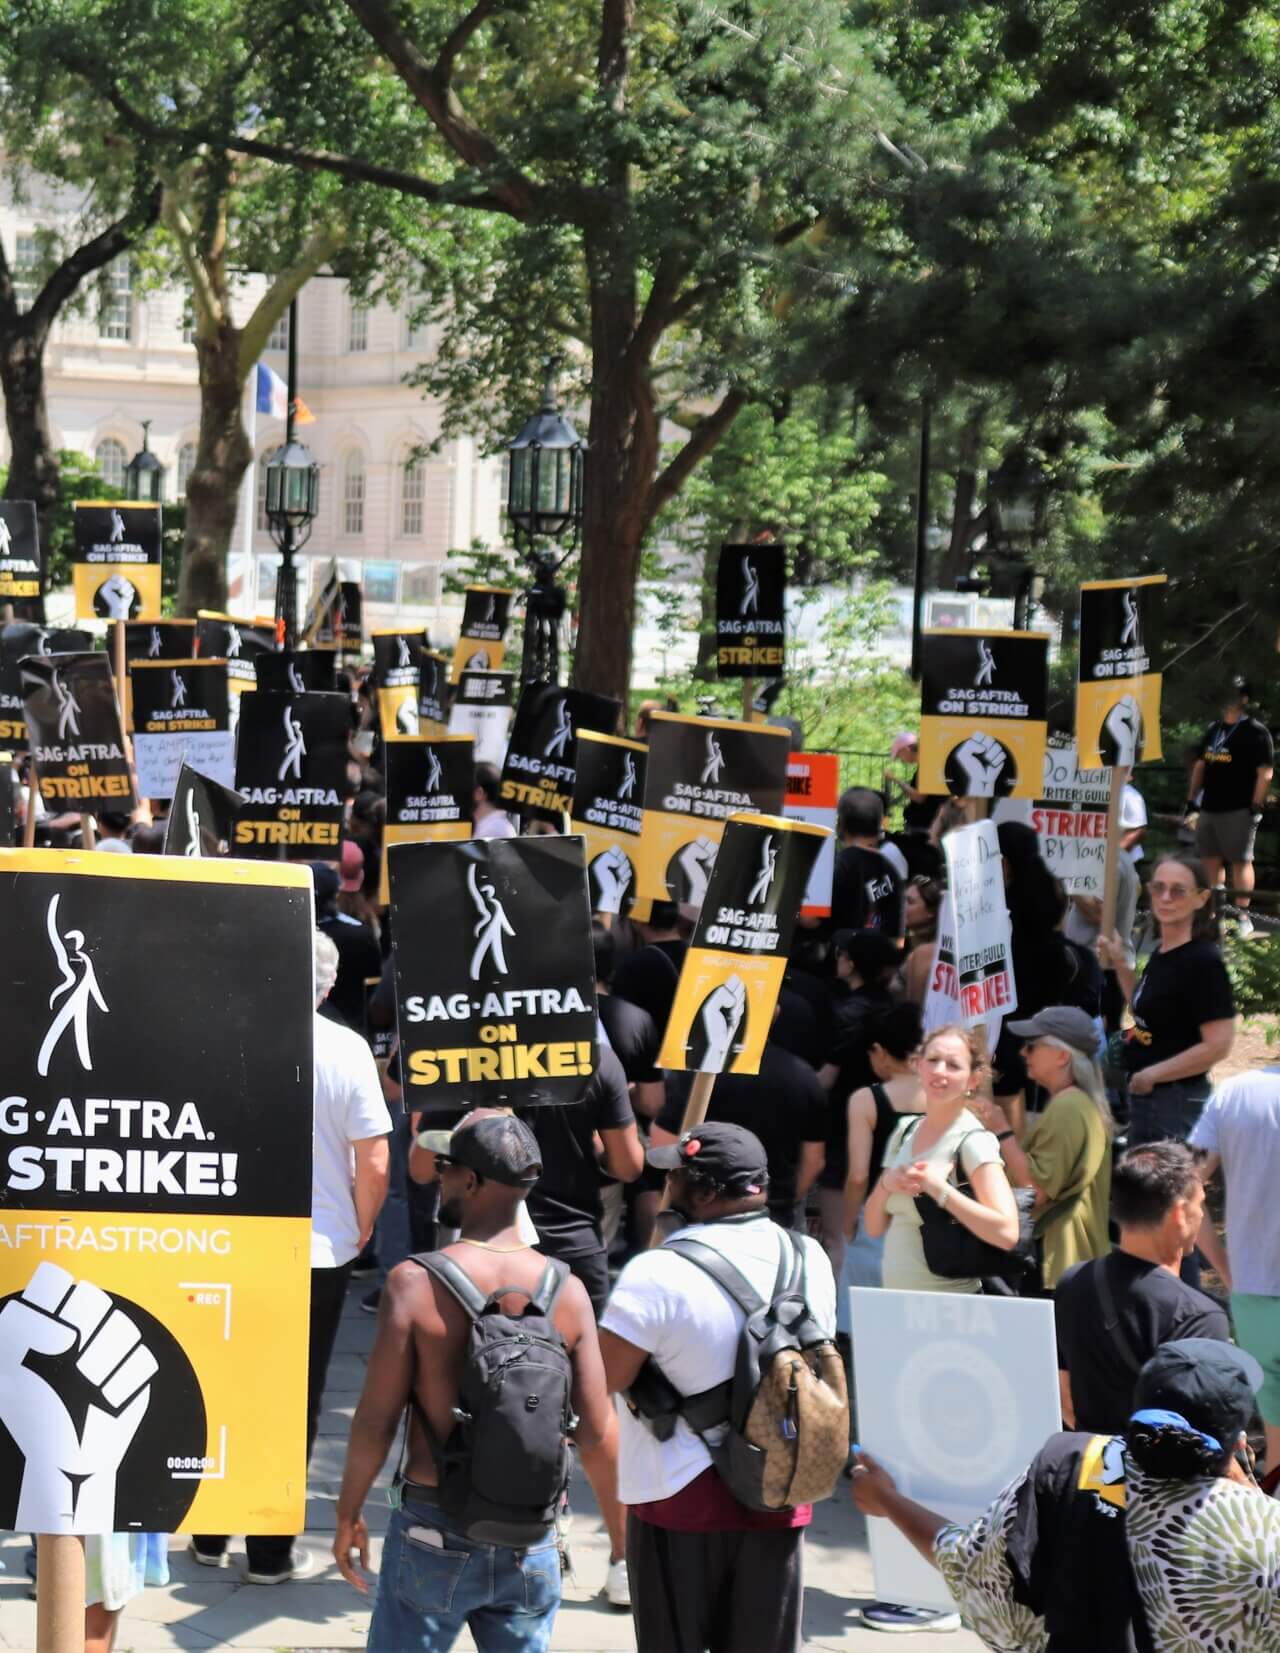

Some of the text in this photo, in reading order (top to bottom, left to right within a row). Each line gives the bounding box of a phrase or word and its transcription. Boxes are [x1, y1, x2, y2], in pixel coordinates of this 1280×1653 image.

[86, 552, 148, 562] ON STRIKE!
[719, 647, 785, 665] STRIKE!
[1093, 663, 1114, 677] ON
[938, 700, 1029, 716] ON STRIKE!
[146, 719, 217, 732] ON STRIKE!
[67, 763, 89, 776] ON
[40, 775, 131, 799] STRIKE!
[538, 779, 558, 790] ON
[1043, 787, 1082, 800] RITERS
[663, 795, 690, 812] ON
[278, 808, 301, 820] ON
[398, 808, 419, 821] ON
[585, 808, 606, 825] ON
[235, 820, 340, 845] STRIKE!
[1045, 838, 1069, 859] BY
[706, 925, 780, 950] ON STRIKE!
[480, 1024, 518, 1043] ON
[407, 1042, 594, 1086] STRIKE!
[7, 1146, 239, 1197] STRIKE!
[196, 1293, 221, 1305] REC
[167, 1456, 215, 1469] 00:00:00
